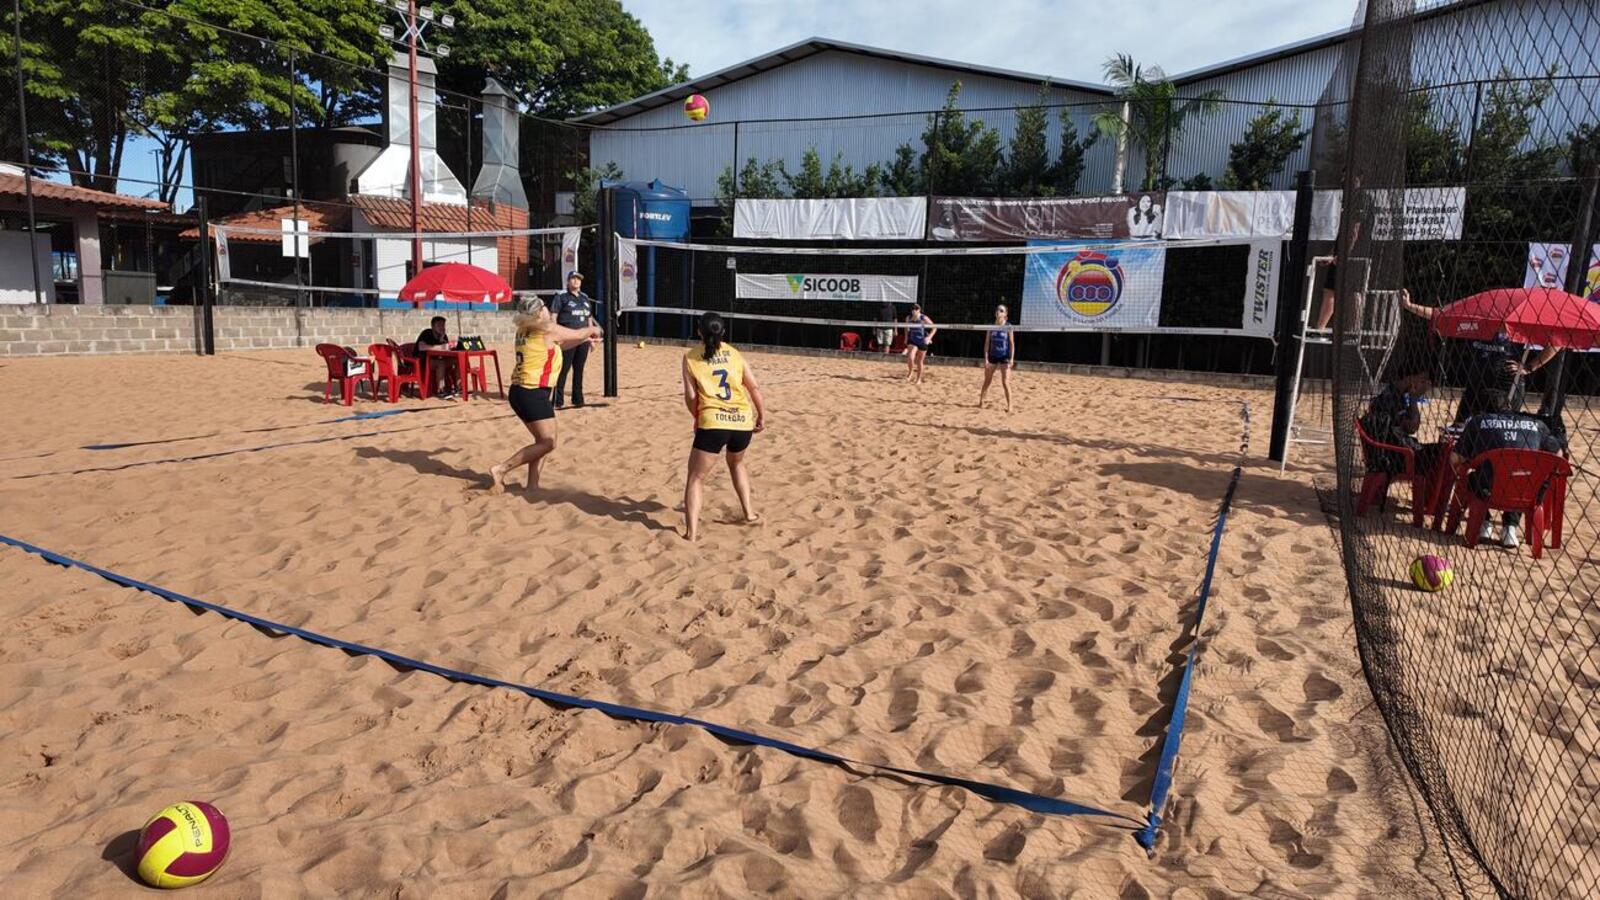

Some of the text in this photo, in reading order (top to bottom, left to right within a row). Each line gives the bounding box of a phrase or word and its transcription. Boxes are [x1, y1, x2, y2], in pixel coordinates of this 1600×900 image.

[639, 211, 672, 222] FORTLEV
[803, 278, 861, 293] SICOOB
[1252, 243, 1270, 325] TWISTER
[712, 369, 732, 401] 3
